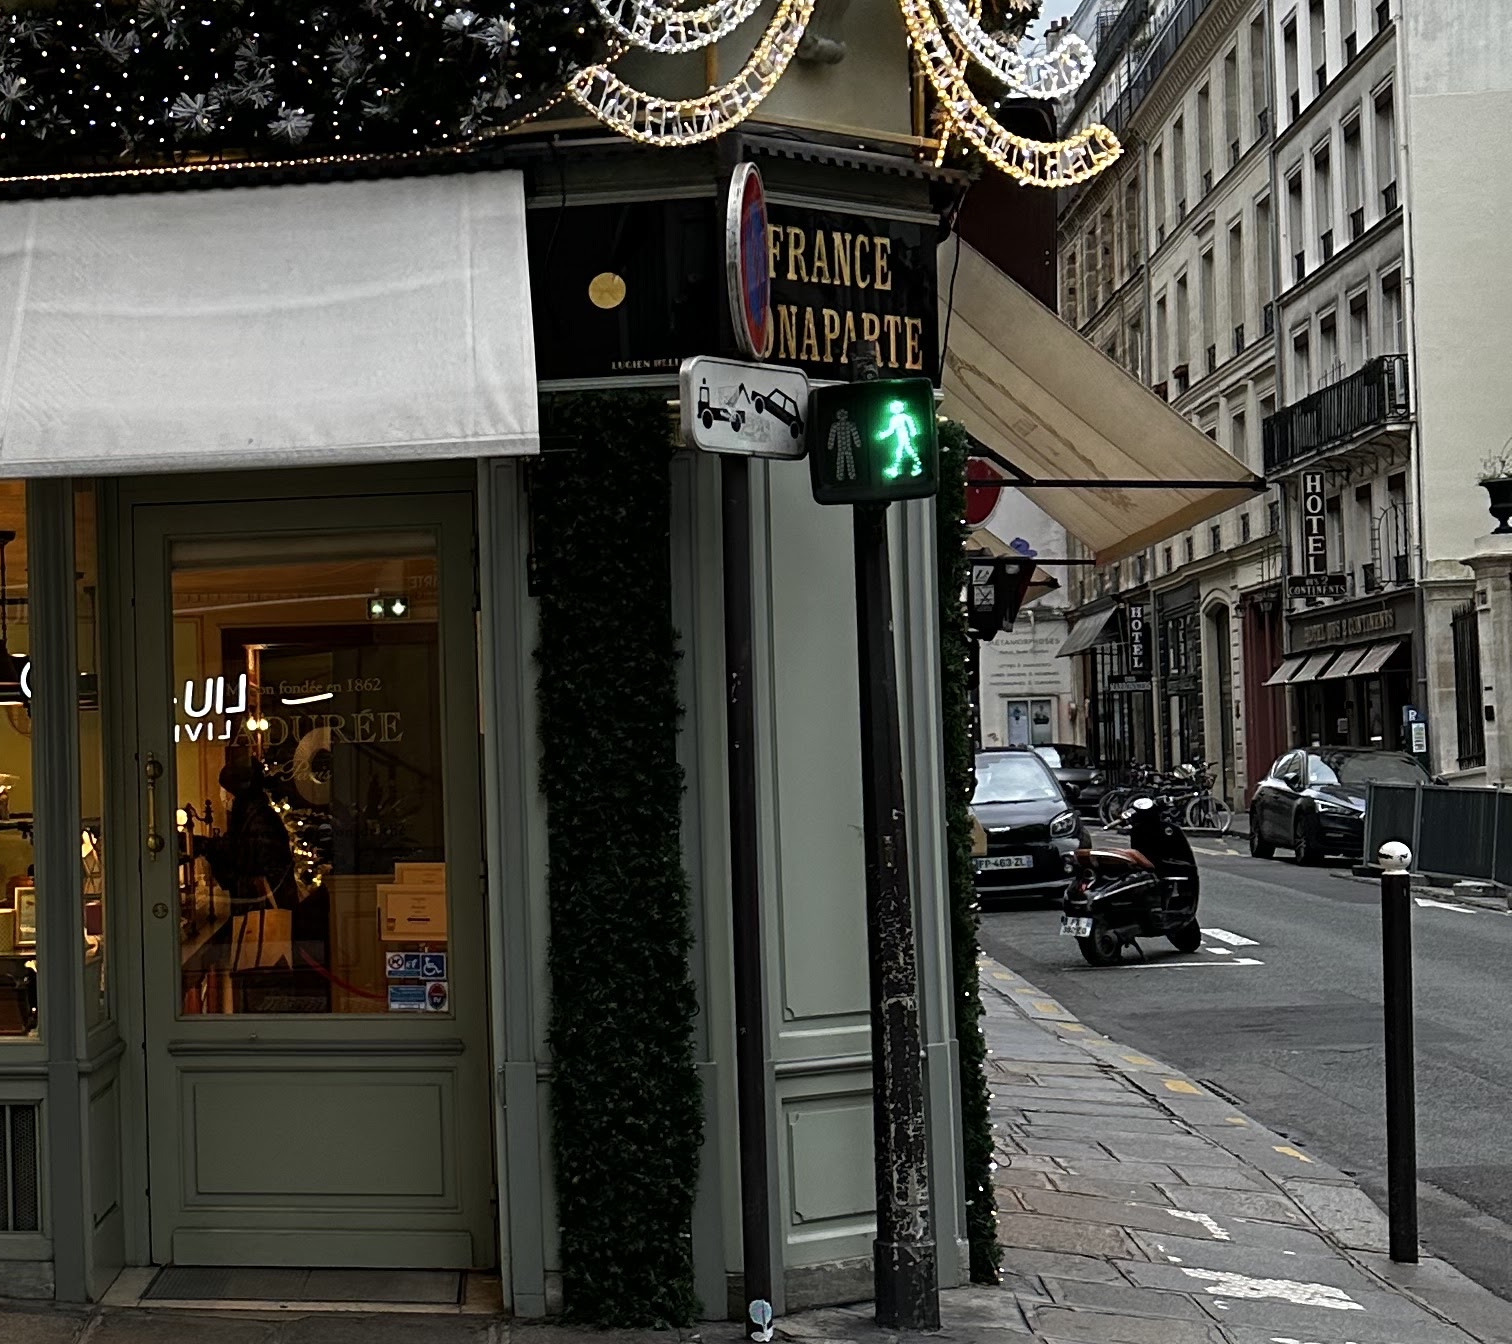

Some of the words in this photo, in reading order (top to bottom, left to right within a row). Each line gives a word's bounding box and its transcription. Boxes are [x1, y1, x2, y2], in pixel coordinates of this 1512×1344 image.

[768, 223, 892, 291] FRANCE
[1305, 474, 1327, 575] HOTEL
[1131, 606, 1144, 668] HOTEL
[279, 680, 323, 695] fondée
[346, 678, 382, 692] 1862
